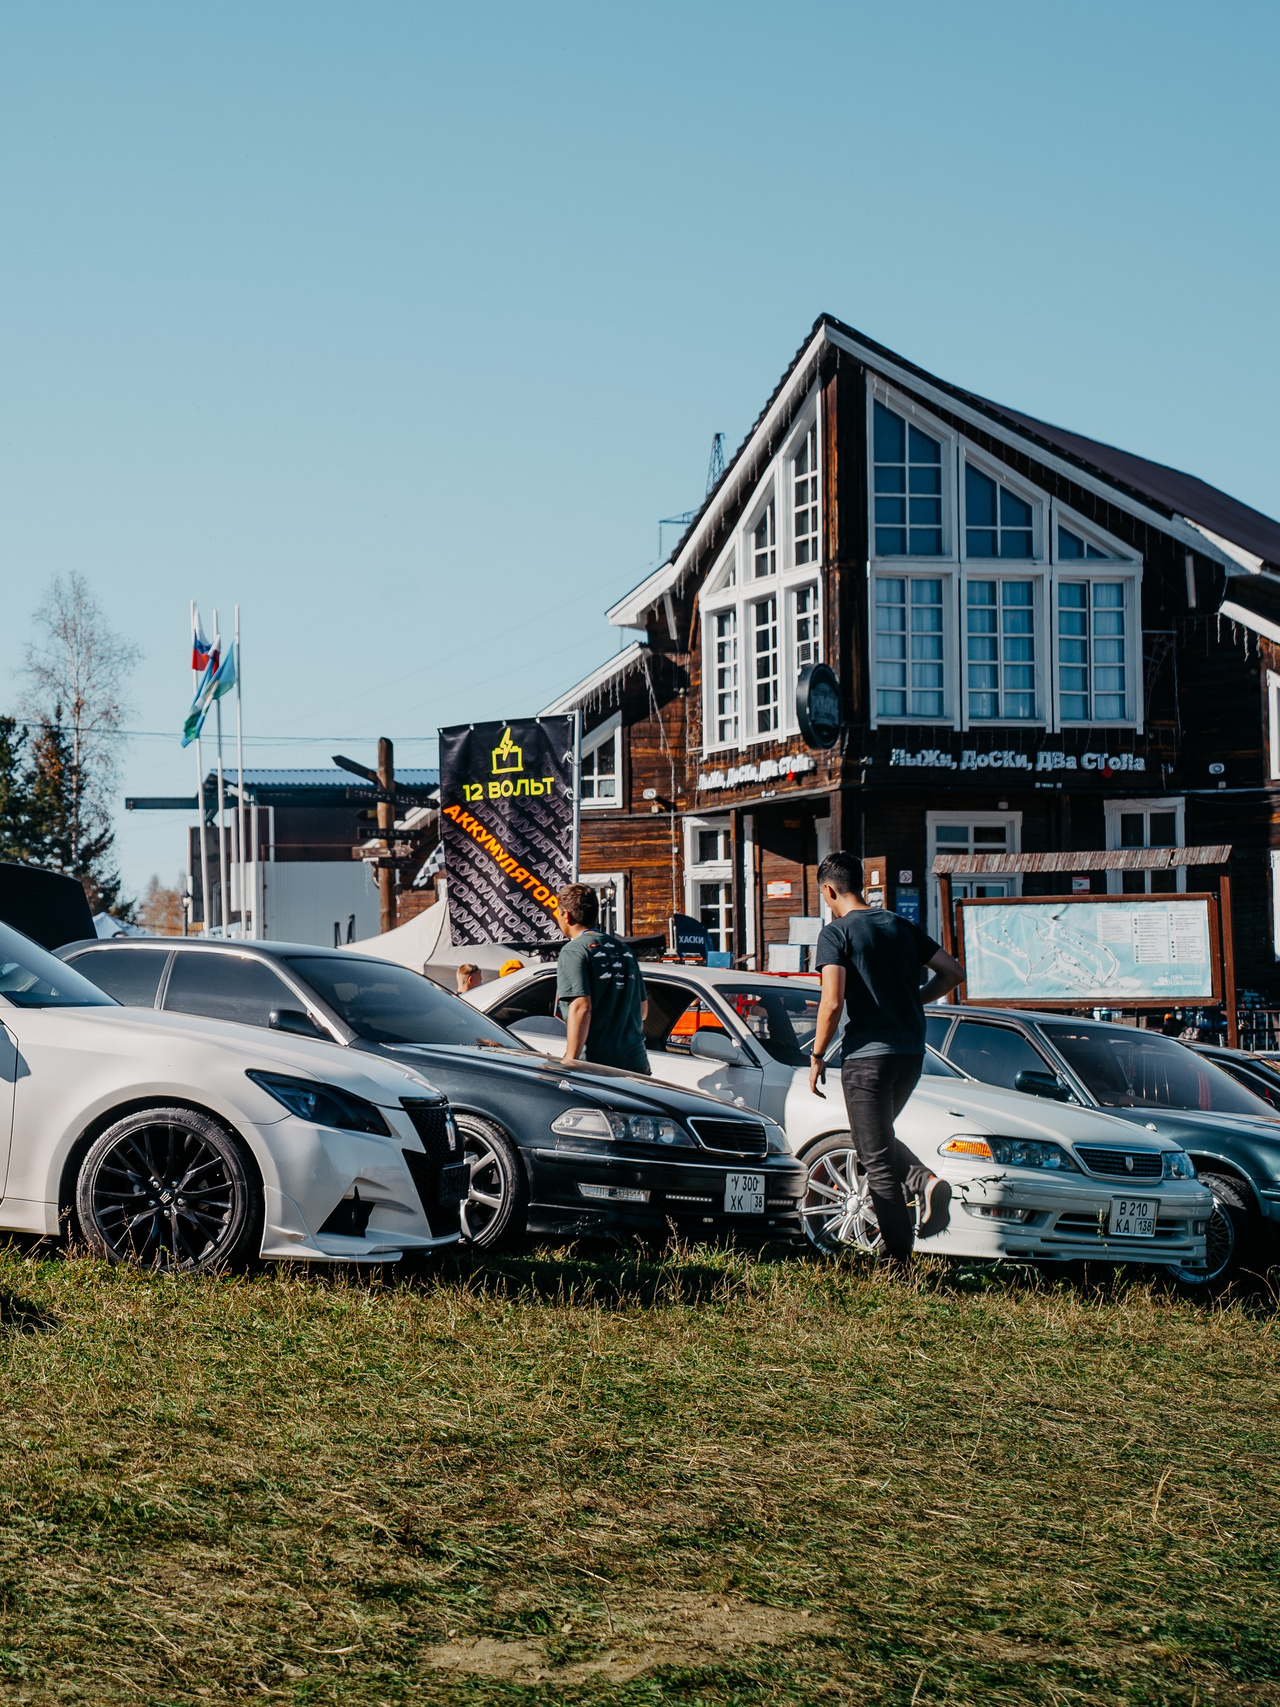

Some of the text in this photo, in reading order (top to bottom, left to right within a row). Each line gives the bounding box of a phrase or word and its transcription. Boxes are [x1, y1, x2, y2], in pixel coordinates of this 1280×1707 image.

[462, 777, 555, 802] 12 ВОЛЬТ
[678, 935, 705, 945] ХАСКИ
[754, 1196, 763, 1208] 38
[1129, 1202, 1148, 1217] 210
[1115, 1218, 1152, 1233] КА 138
